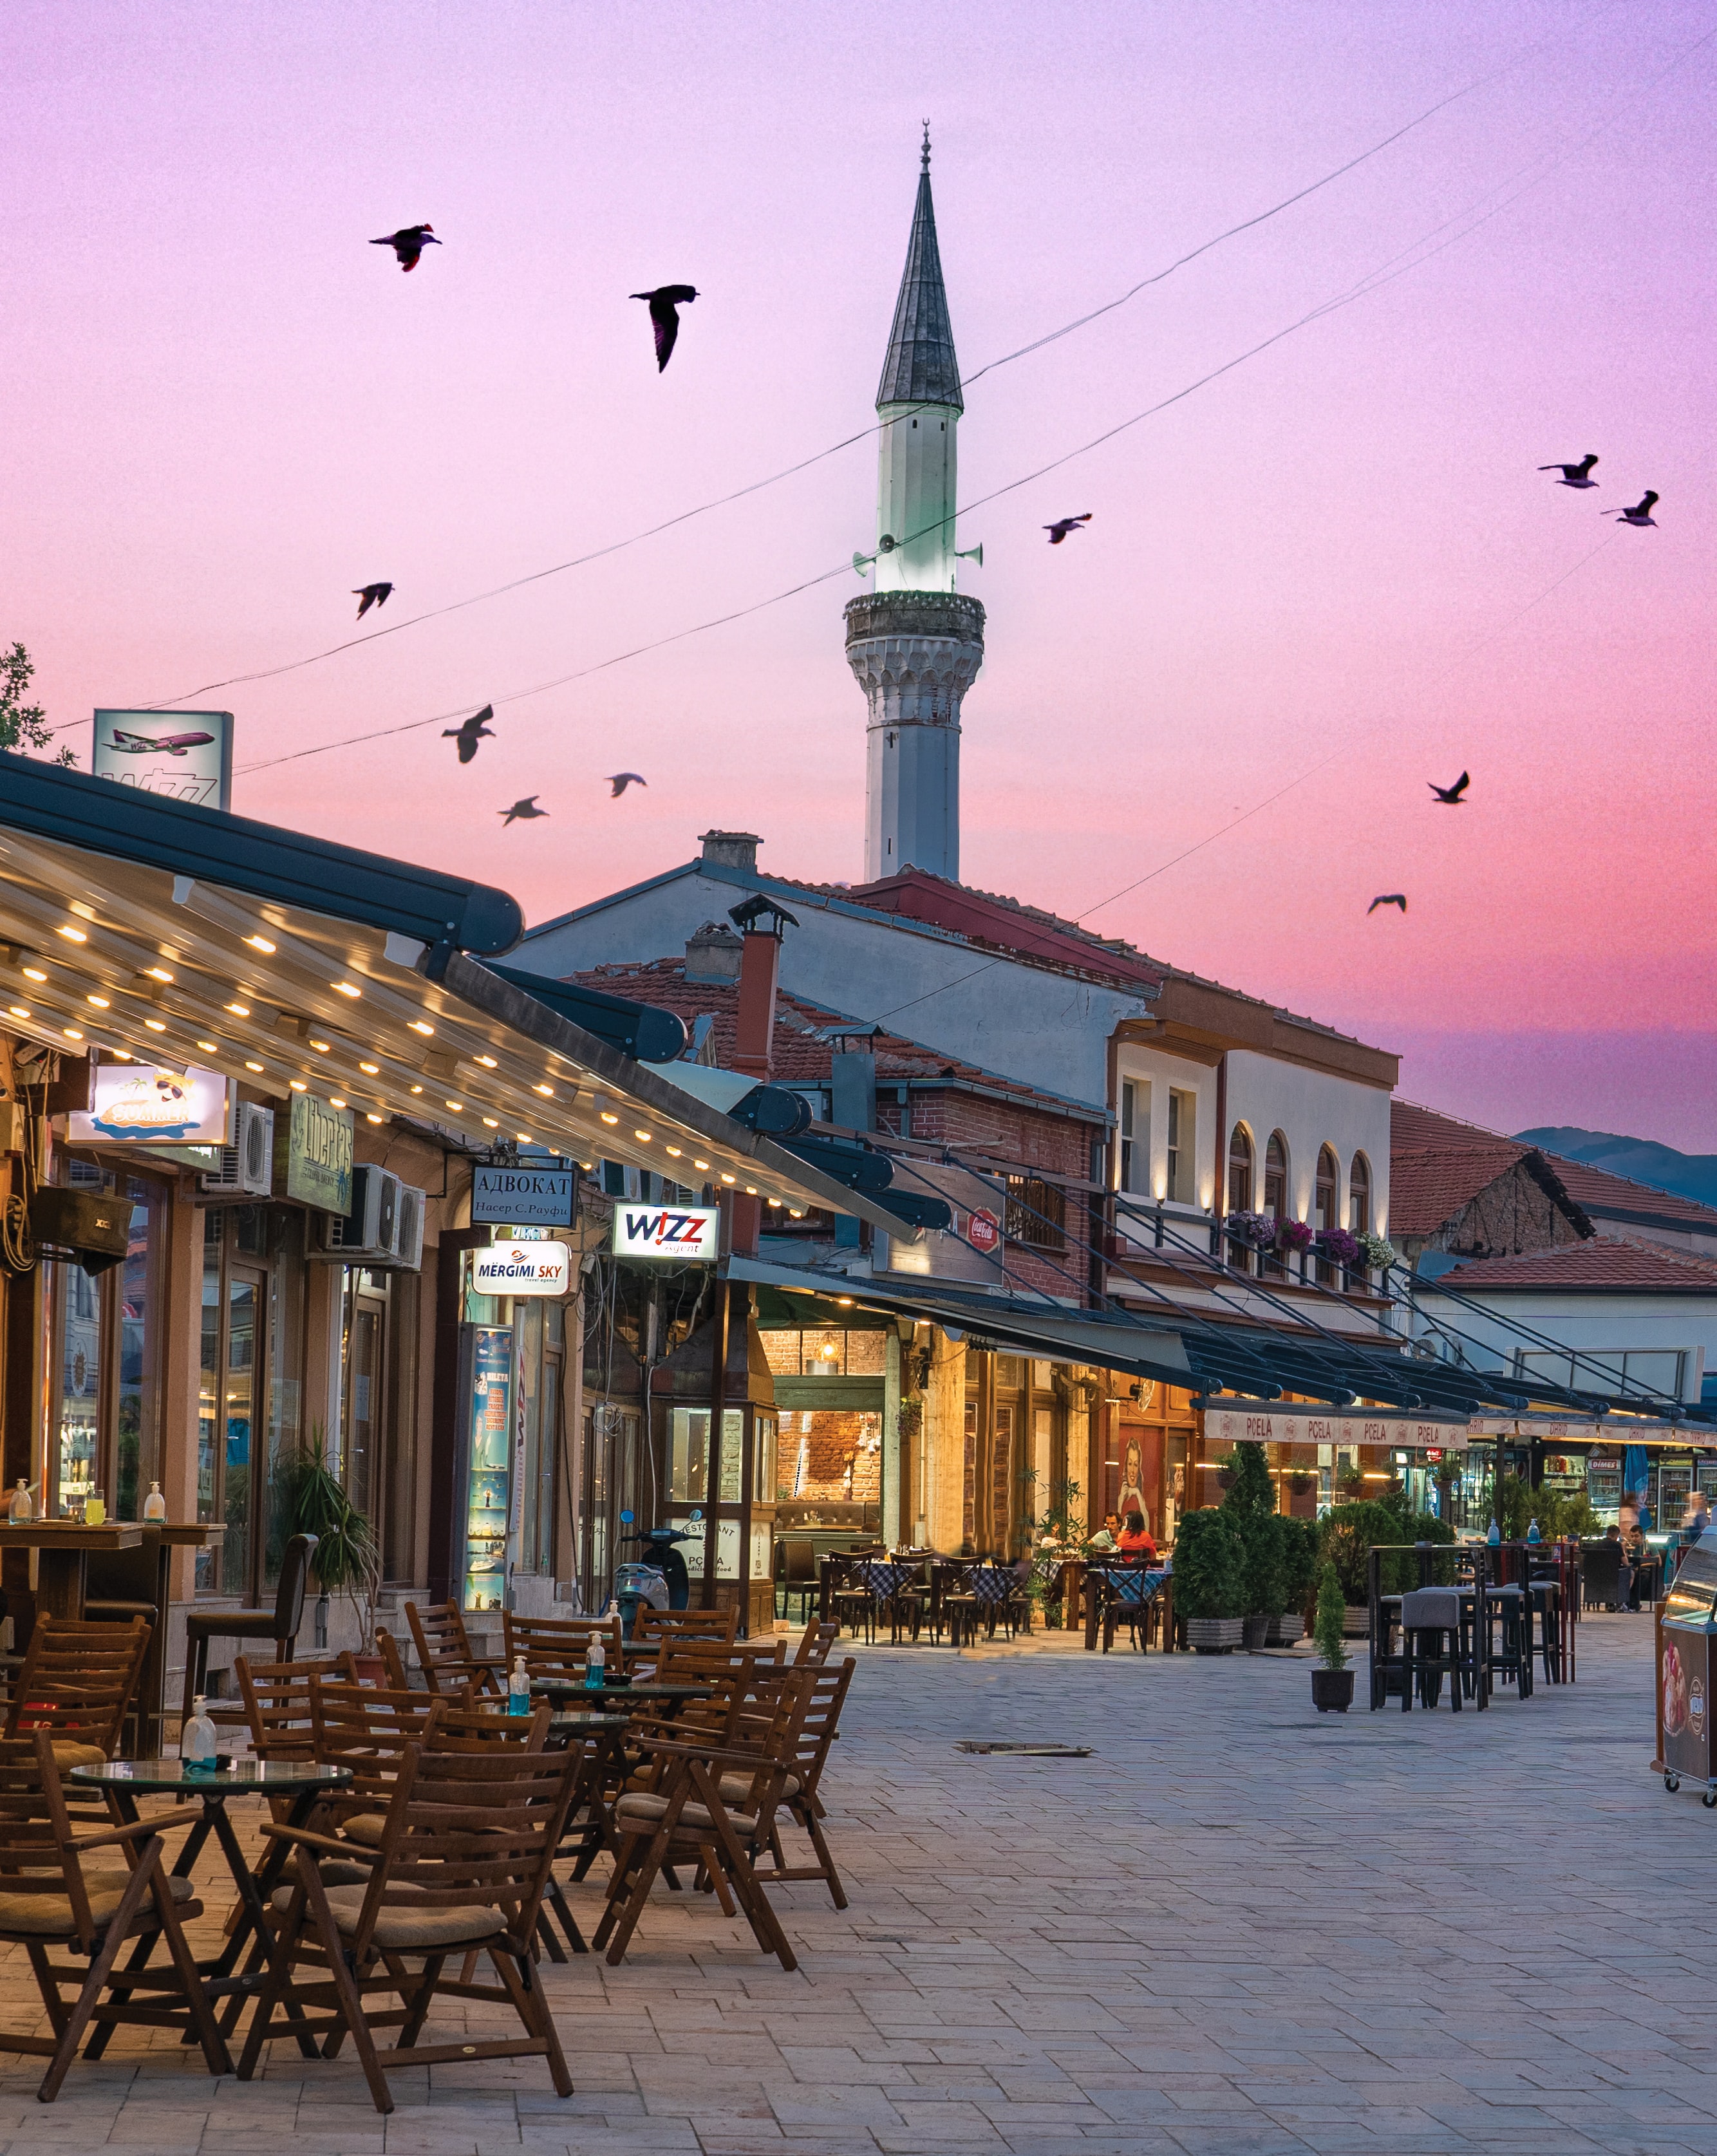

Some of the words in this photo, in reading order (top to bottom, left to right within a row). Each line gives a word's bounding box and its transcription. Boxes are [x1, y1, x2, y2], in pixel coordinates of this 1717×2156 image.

[112, 1103, 191, 1123] SUMMER
[478, 1174, 570, 1195] АДВОКАТ
[475, 1201, 511, 1215] Насер
[665, 1244, 700, 1253] Agent
[478, 1262, 534, 1277] MËRGIMI
[538, 1266, 562, 1278] SKY
[1247, 1417, 1272, 1439] PÇELA
[1308, 1421, 1331, 1441] PÇELA
[1365, 1423, 1386, 1443] PÇELA
[1418, 1426, 1439, 1445] PÇELA
[689, 1557, 723, 1566] PÇA
